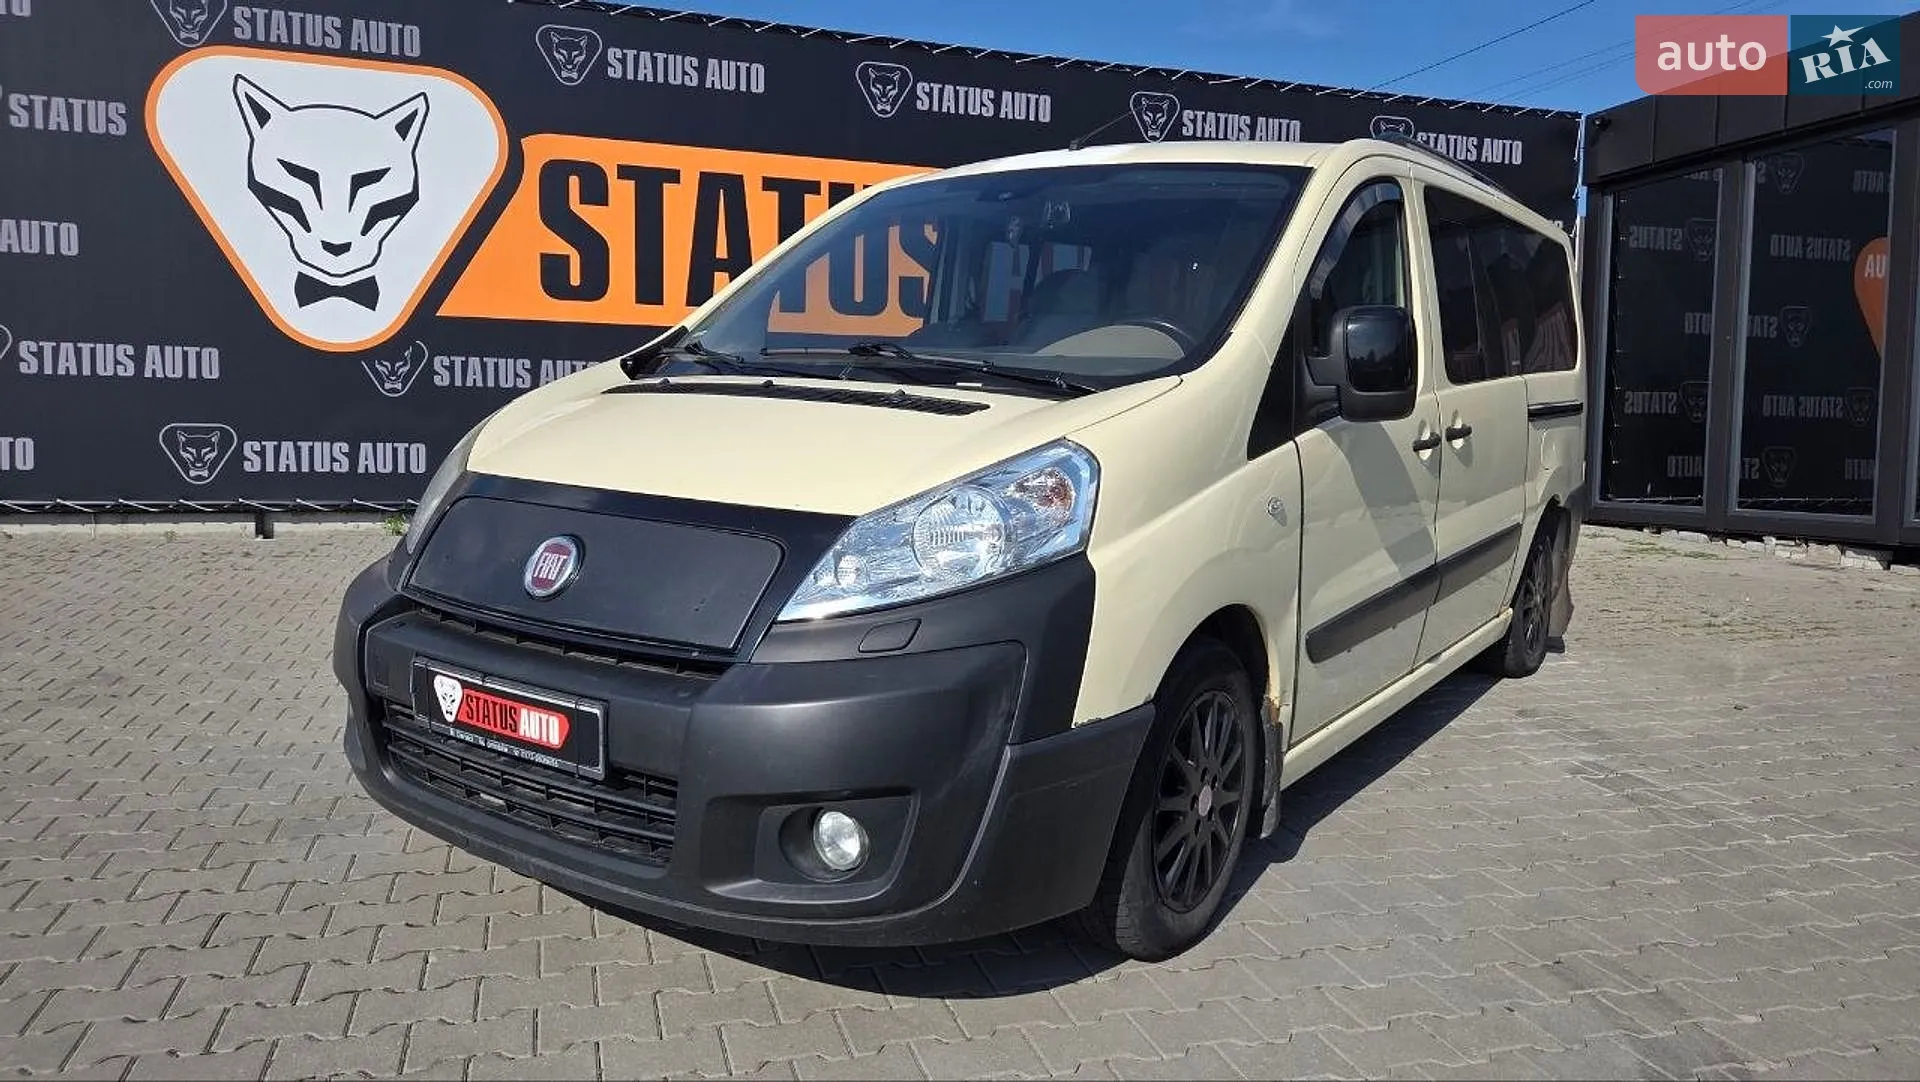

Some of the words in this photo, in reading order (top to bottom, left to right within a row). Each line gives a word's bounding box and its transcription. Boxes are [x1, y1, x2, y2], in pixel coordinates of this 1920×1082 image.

[233, 6, 342, 49] STATUS
[350, 19, 421, 57] AUTO
[607, 47, 699, 86] STATUS
[705, 58, 765, 94] AUTO
[8, 93, 128, 136] STATUS
[916, 81, 995, 117] STATUS
[1000, 90, 1052, 122] AUTO
[1182, 109, 1251, 140] STATUS
[1256, 116, 1301, 141] AUTO
[1481, 138, 1523, 165] AUTO
[0, 218, 79, 256] AUTO
[18, 340, 134, 377] STATUS
[144, 344, 220, 380] AUTO
[433, 355, 531, 388] STATUS
[0, 436, 35, 471] TO
[242, 441, 350, 474] STATUS
[357, 442, 427, 474] AUTO
[533, 552, 568, 580] FIAT
[466, 694, 518, 734] STATUS
[519, 708, 561, 746] AUTO
